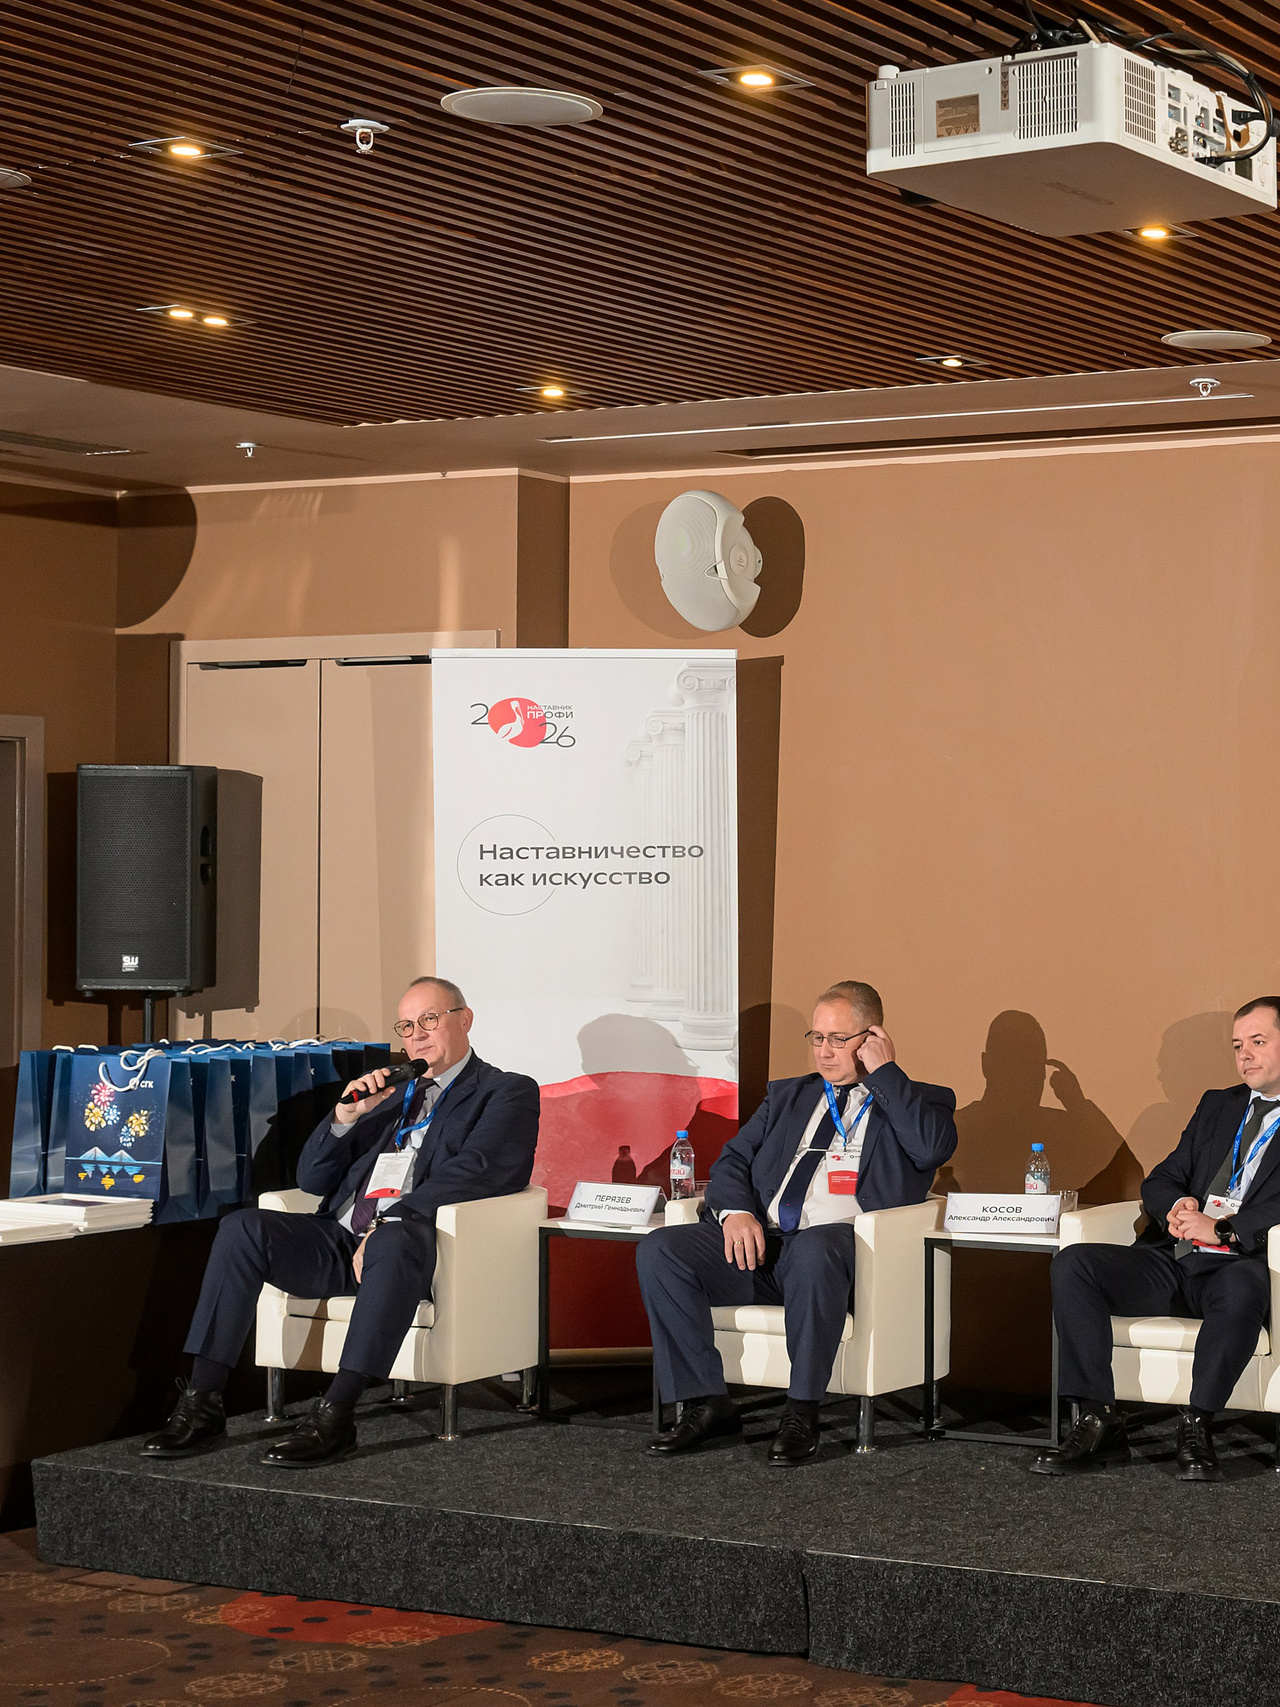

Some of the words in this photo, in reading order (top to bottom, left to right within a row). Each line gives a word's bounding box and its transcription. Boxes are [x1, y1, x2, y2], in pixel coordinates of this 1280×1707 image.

[527, 711, 574, 719] ПРОФИ
[479, 843, 705, 861] Наставничество
[479, 871, 525, 887] как
[531, 870, 671, 889] искусство
[140, 1080, 154, 1089] СГК
[594, 1194, 632, 1204] ПЕРЯЗЕВ
[575, 1202, 604, 1210] Дмитрий
[604, 1204, 645, 1213] Геннадьевич
[982, 1206, 1023, 1214] КОСОВ
[992, 1215, 1055, 1223] Александрович
